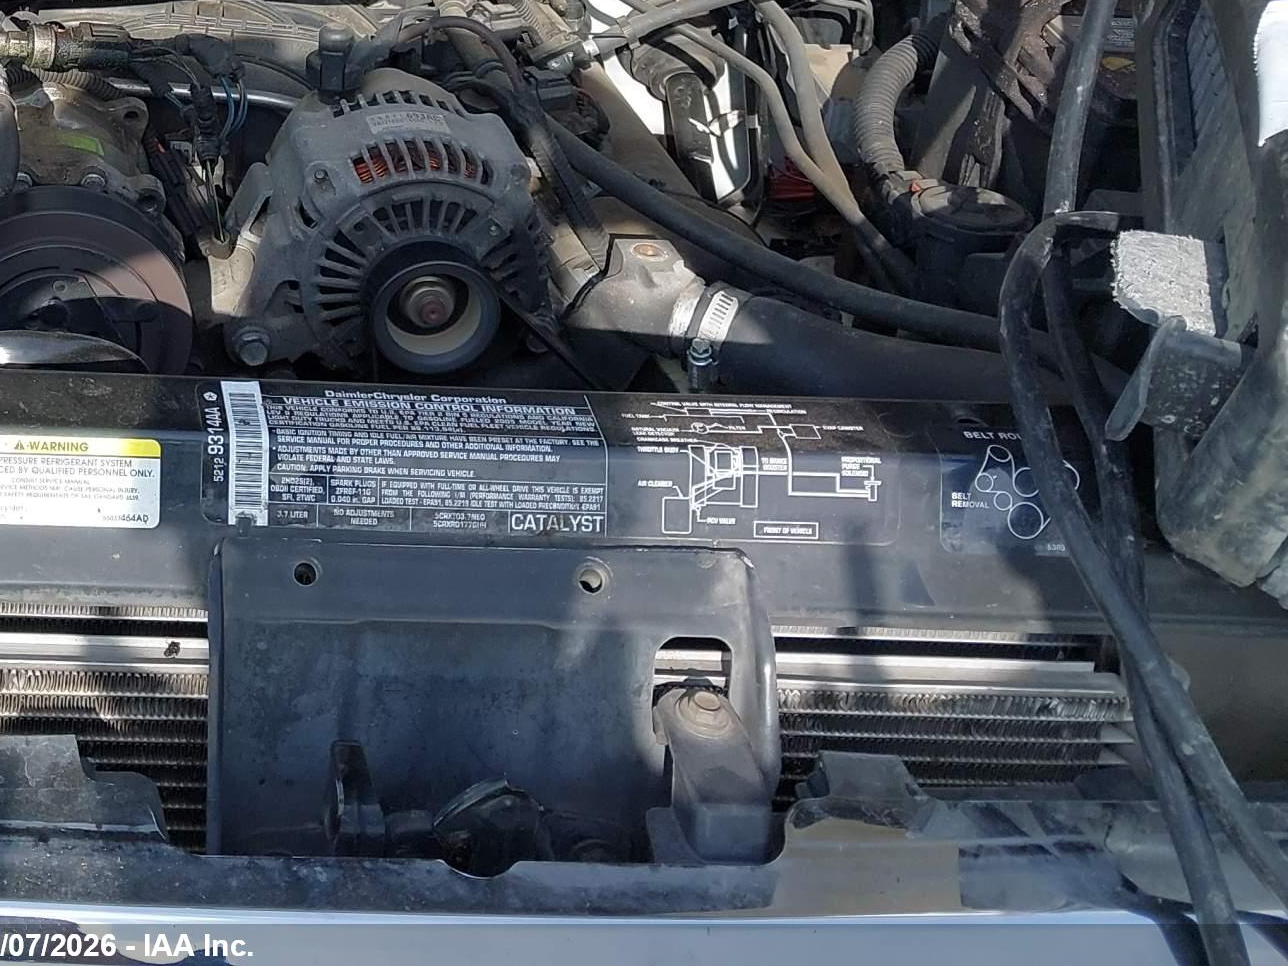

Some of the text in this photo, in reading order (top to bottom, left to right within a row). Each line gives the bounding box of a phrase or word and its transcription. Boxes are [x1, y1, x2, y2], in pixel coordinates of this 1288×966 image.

[430, 394, 507, 405] Corporation
[283, 397, 576, 415] VEHICLE EMISSION CONTROL INFORMATION
[963, 431, 994, 439] BELT
[29, 441, 89, 452] WARNING
[203, 406, 225, 483] 5212 9314AA
[277, 435, 305, 443] SERVICE
[306, 436, 336, 444] MANUAL
[464, 443, 504, 451] ADDITIONAL
[277, 445, 326, 454] ADJUSTMENTS
[327, 447, 348, 455] MADE
[359, 448, 381, 456] OTHER
[383, 449, 402, 457] THAN
[403, 450, 439, 458] APPROVED
[440, 452, 468, 460] SERVICE
[469, 453, 499, 461] MANUAL
[499, 453, 544, 462] PROCEDURES
[544, 454, 561, 463] MAY
[305, 454, 335, 463] FEDERAL
[40, 457, 98, 466] REFRIGERANT
[100, 459, 133, 468] SYSTEM
[18, 466, 29, 474] BY
[31, 466, 75, 475] QUALIFIED
[78, 468, 128, 477] PERSONNEL
[129, 469, 156, 478] ONLY.
[309, 464, 331, 472] APPLY
[332, 465, 362, 474] PARKING
[363, 466, 386, 474] BRAKE
[387, 467, 409, 475] WHEN
[410, 468, 445, 477] SERVICING
[330, 479, 377, 488] SPARK PLUGS
[389, 481, 418, 489] EQUIPPED
[420, 482, 435, 490] WITH
[468, 483, 477, 491] OR
[512, 485, 529, 493] DRIVE
[546, 486, 570, 494] VEHICLE
[580, 487, 604, 495] EXEMPT
[330, 495, 376, 504] 0.040 GAP
[381, 488, 398, 496] FROM
[418, 490, 451, 498] FOLLOWING
[518, 494, 551, 502] WARRANTY
[951, 492, 971, 500] BELT
[381, 497, 404, 505] LOADED
[951, 500, 991, 509] REMOVAL
[289, 511, 309, 519] LITER
[333, 508, 395, 518] NO ADJUSTMENTS
[350, 517, 378, 526] NEEDED
[511, 513, 604, 533] CATALYST
